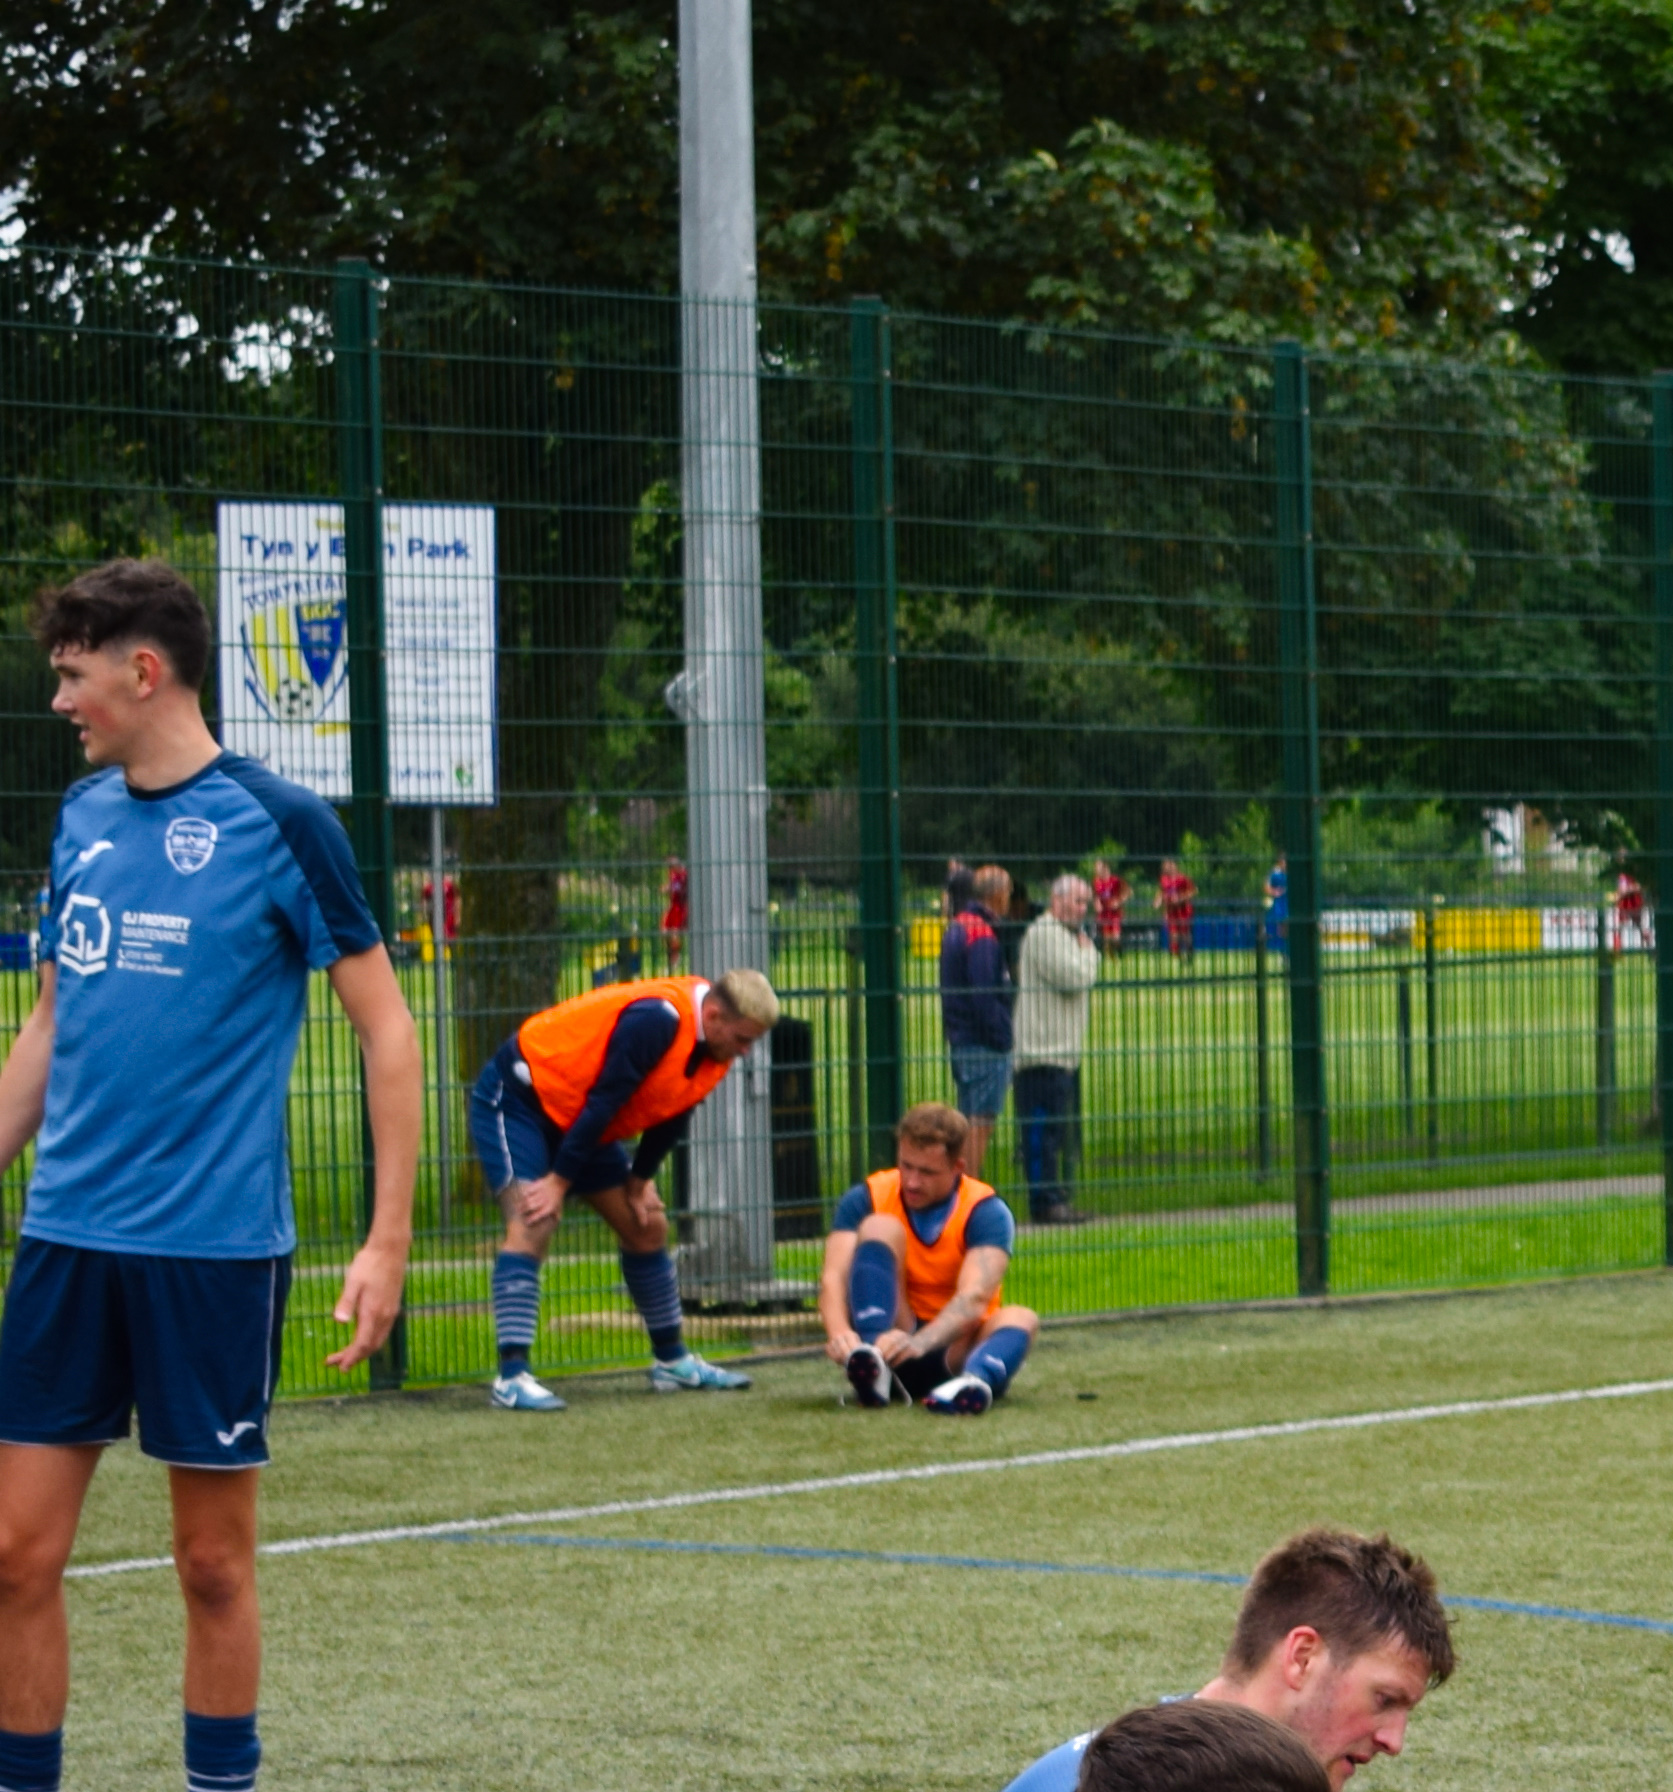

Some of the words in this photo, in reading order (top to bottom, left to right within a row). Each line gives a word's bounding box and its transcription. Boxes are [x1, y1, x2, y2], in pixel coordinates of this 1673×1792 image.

[240, 535, 293, 561] Tyn
[306, 541, 319, 561] y
[408, 537, 471, 559] Park
[139, 912, 191, 931] PROPERTY
